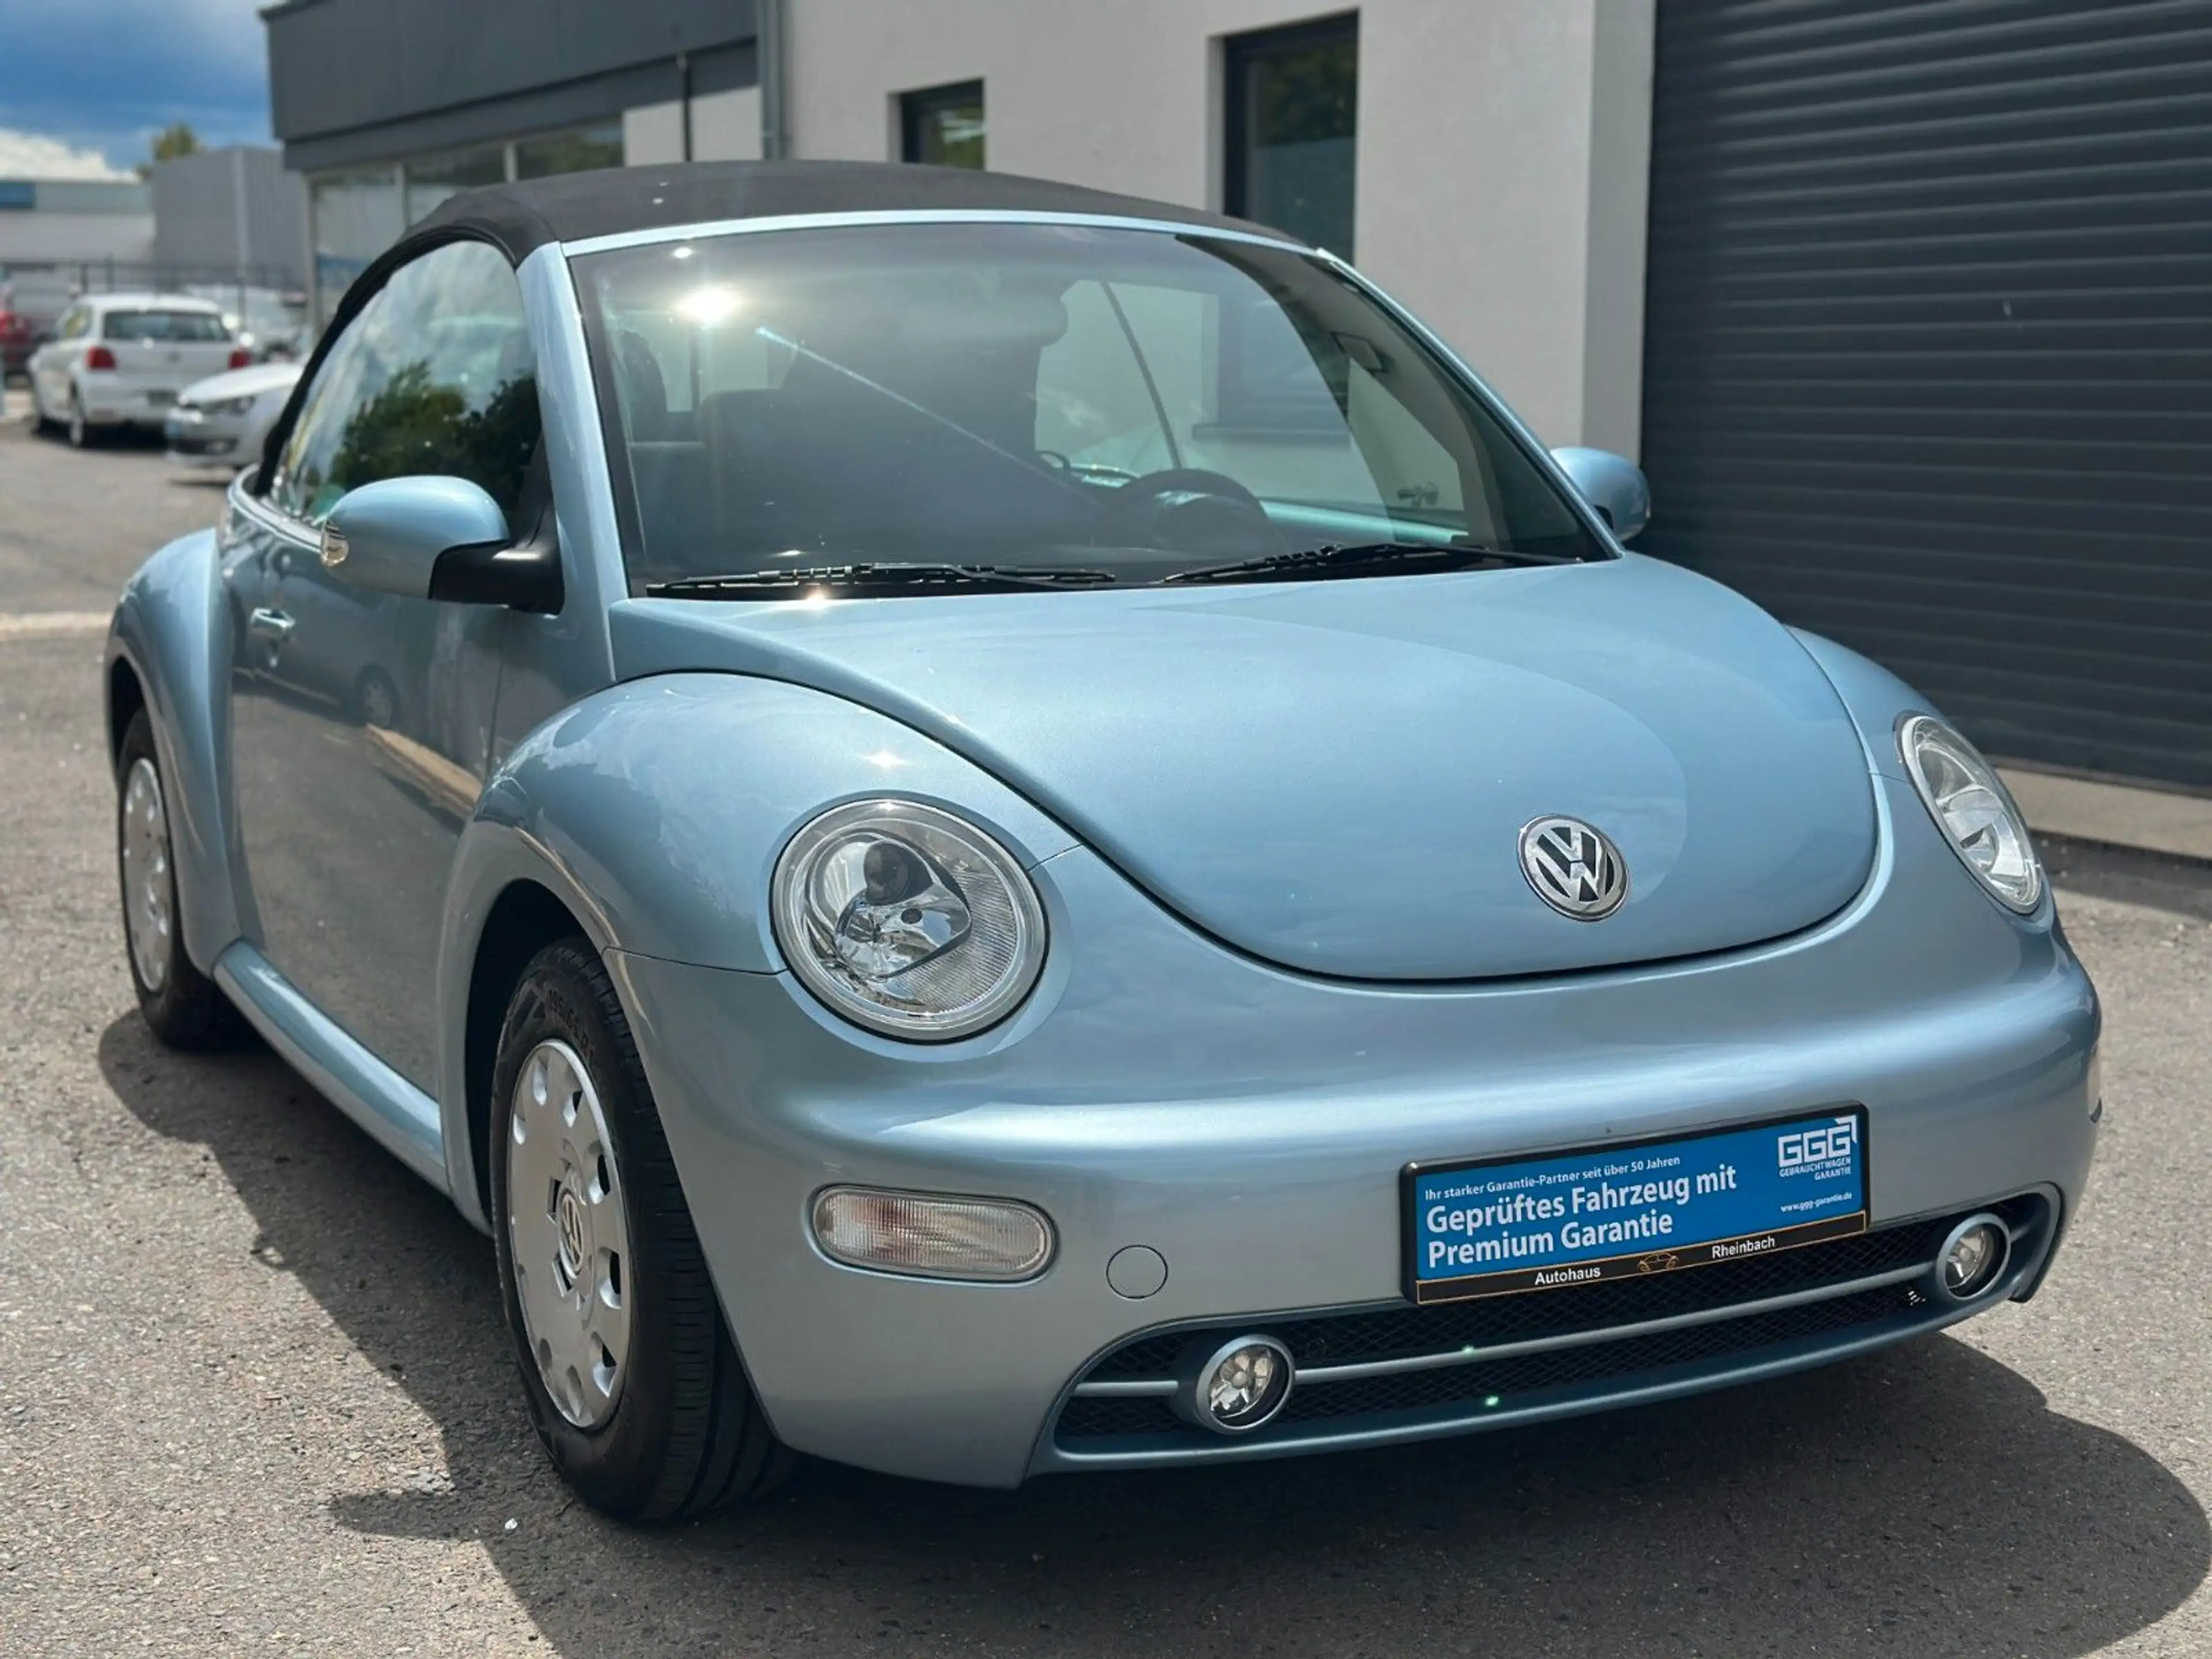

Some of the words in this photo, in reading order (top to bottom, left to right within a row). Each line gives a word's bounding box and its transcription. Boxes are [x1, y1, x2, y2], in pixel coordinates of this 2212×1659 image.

[1778, 1124, 1851, 1168] GGG
[1779, 1157, 1851, 1178] GEBRAUCHTWAGEN
[1425, 1188, 1442, 1202] Ihr
[1444, 1182, 1484, 1199] starker
[1486, 1171, 1580, 1193] Garantie-Partner
[1582, 1166, 1602, 1180] seit
[1604, 1162, 1628, 1176] über
[1631, 1161, 1643, 1173] 50
[1646, 1156, 1681, 1171] Jahren
[1814, 1167, 1852, 1181] GARANTIE
[1426, 1193, 1566, 1236] Geprüftes
[1571, 1176, 1690, 1214] Fahrzeug
[1696, 1163, 1737, 1195] mit
[1780, 1191, 1853, 1213] www.ggg-garantie.de
[1428, 1230, 1554, 1268] Premium
[1560, 1208, 1673, 1249] Garantie
[1534, 1267, 1602, 1286] Autohaus
[1711, 1235, 1776, 1259] Rheinbach
